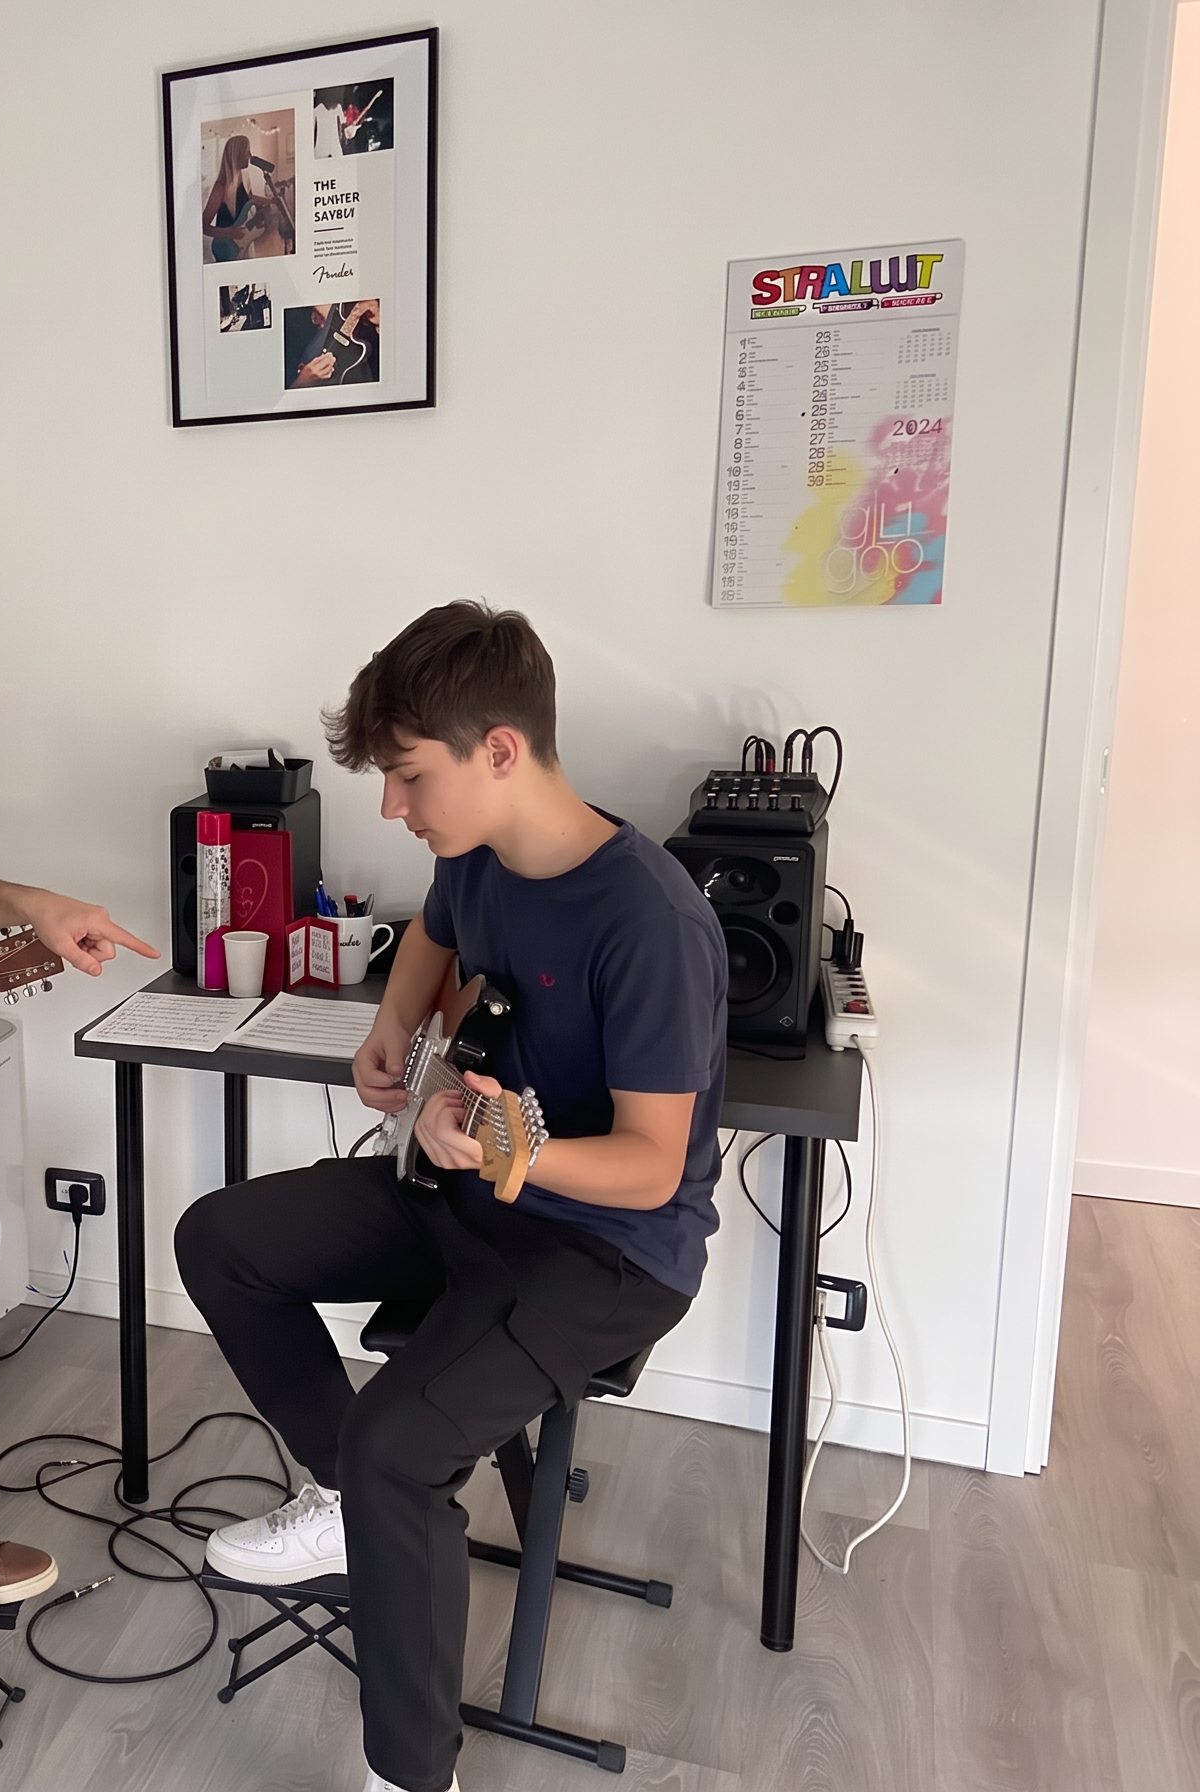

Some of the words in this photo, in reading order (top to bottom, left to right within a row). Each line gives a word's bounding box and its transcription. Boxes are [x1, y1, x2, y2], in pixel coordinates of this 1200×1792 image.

[313, 179, 336, 191] THE
[739, 353, 747, 364] 2
[736, 396, 745, 407] 5
[736, 410, 744, 421] 6
[812, 404, 827, 416] 25
[735, 424, 743, 435] 7
[810, 419, 826, 431] 26
[892, 418, 943, 436] 2024
[734, 438, 742, 449] 8
[810, 433, 826, 445] 27
[734, 452, 741, 463] 9
